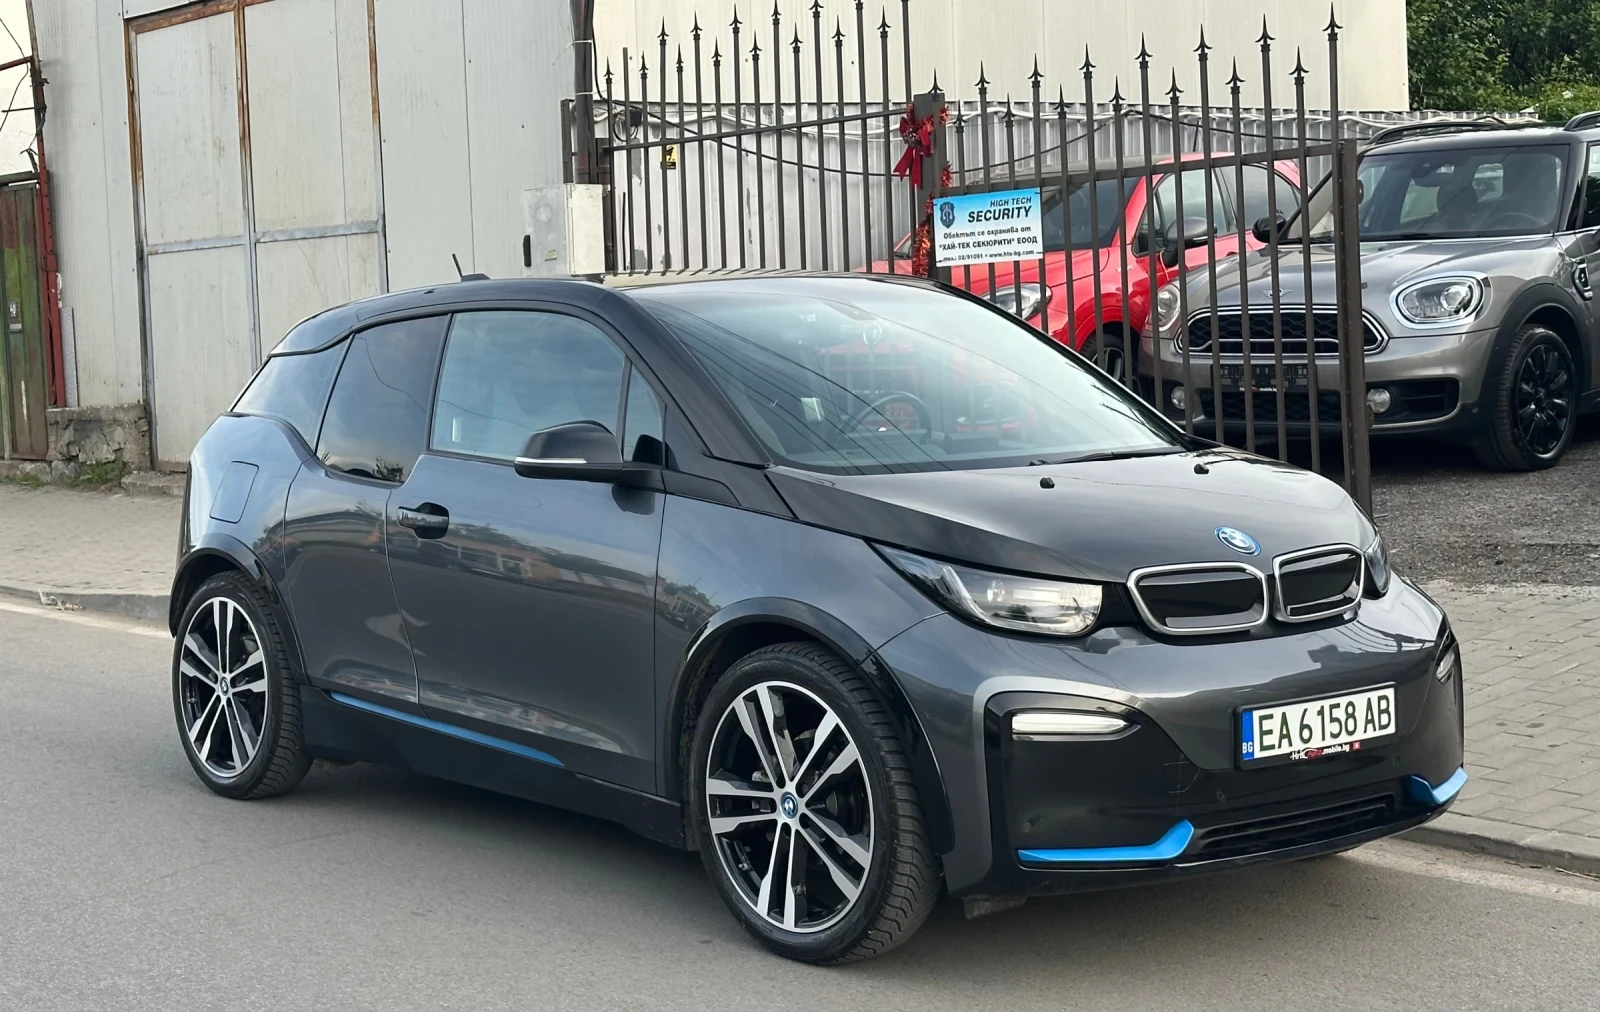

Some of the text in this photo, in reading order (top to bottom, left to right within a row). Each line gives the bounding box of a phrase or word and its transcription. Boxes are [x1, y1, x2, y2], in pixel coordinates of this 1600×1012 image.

[990, 196, 1032, 207] HIGH TECH
[967, 205, 1032, 223] SECURITY
[943, 231, 976, 239] Обектът
[987, 226, 1019, 236] охранява
[939, 236, 1038, 251] "ХАЙ-ТЕК СЕКЮРИТИ" ЕООД
[1258, 694, 1392, 752] EA 6158 AB
[1242, 741, 1253, 753] BG
